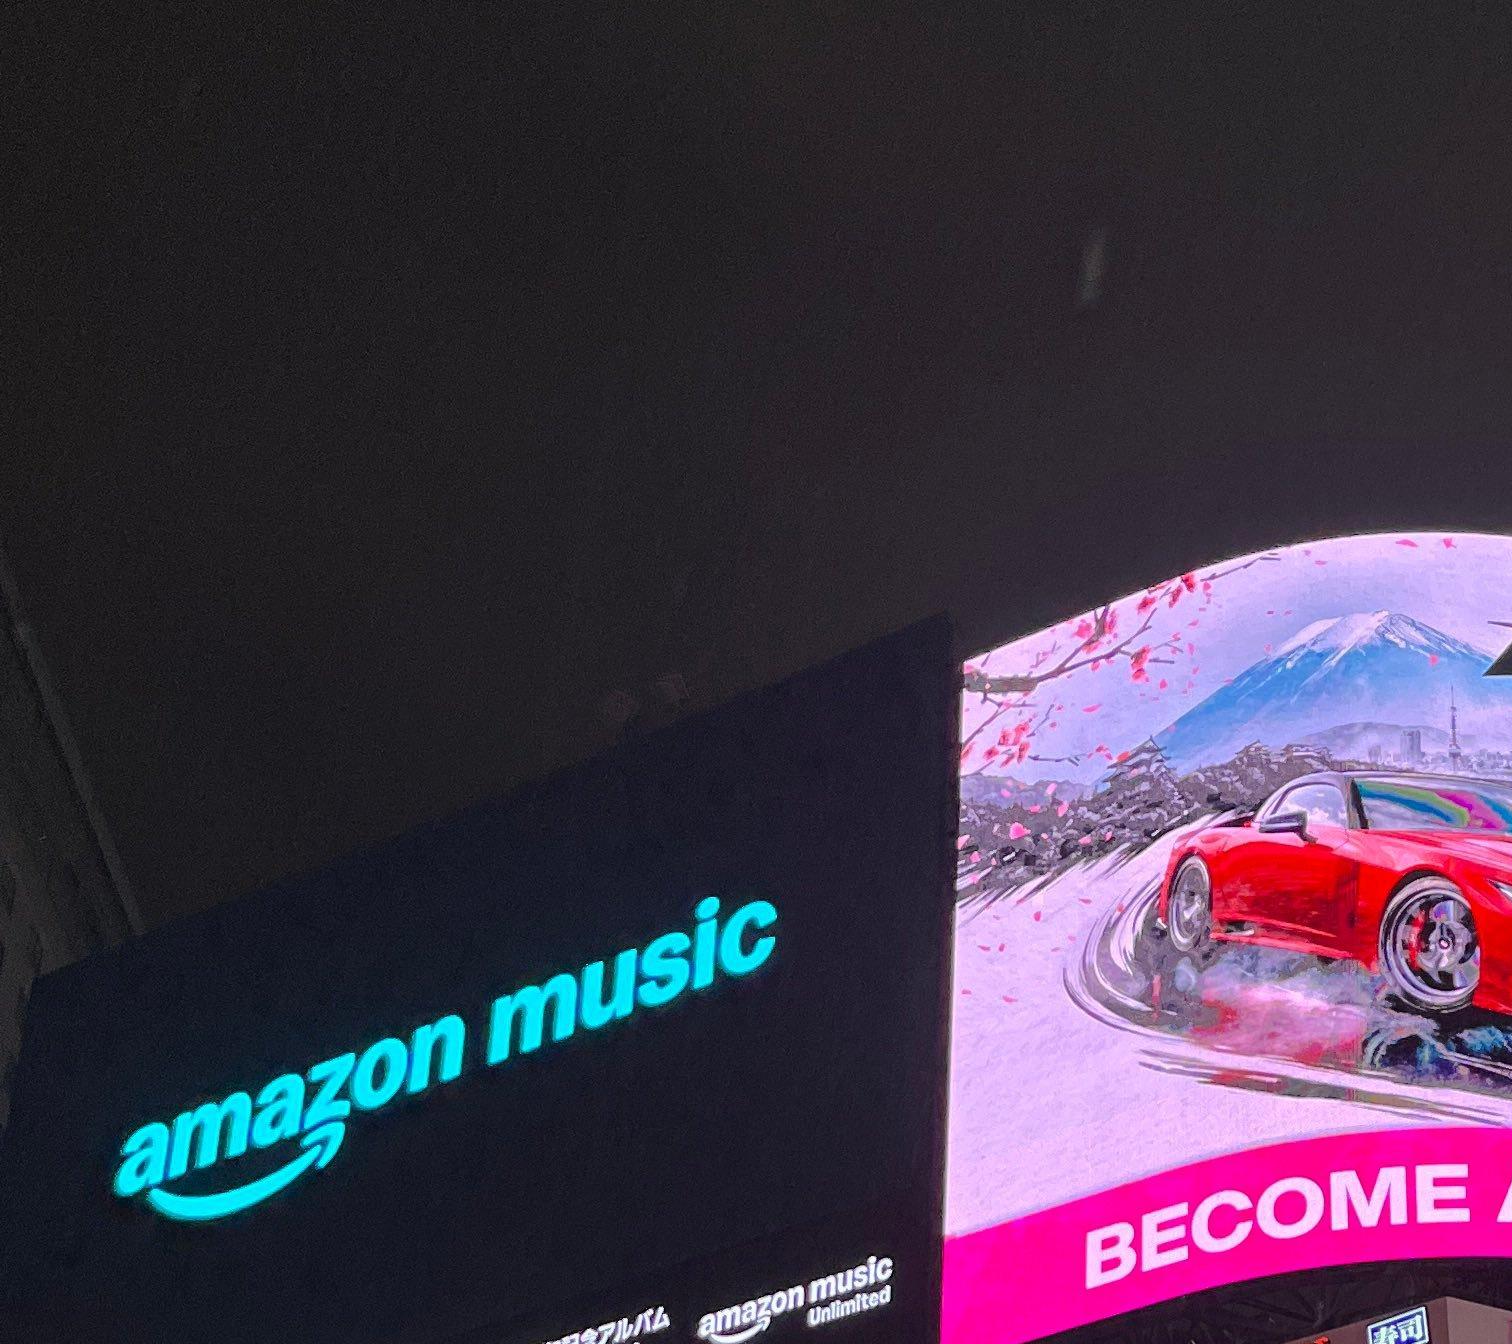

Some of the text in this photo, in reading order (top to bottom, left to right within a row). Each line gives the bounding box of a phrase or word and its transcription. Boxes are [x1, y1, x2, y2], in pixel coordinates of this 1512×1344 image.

[115, 895, 778, 1206] amazon music
[1083, 1166, 1472, 1291] BECOME
[698, 1256, 893, 1340] amazon music
[806, 1285, 892, 1328] Unlimited
